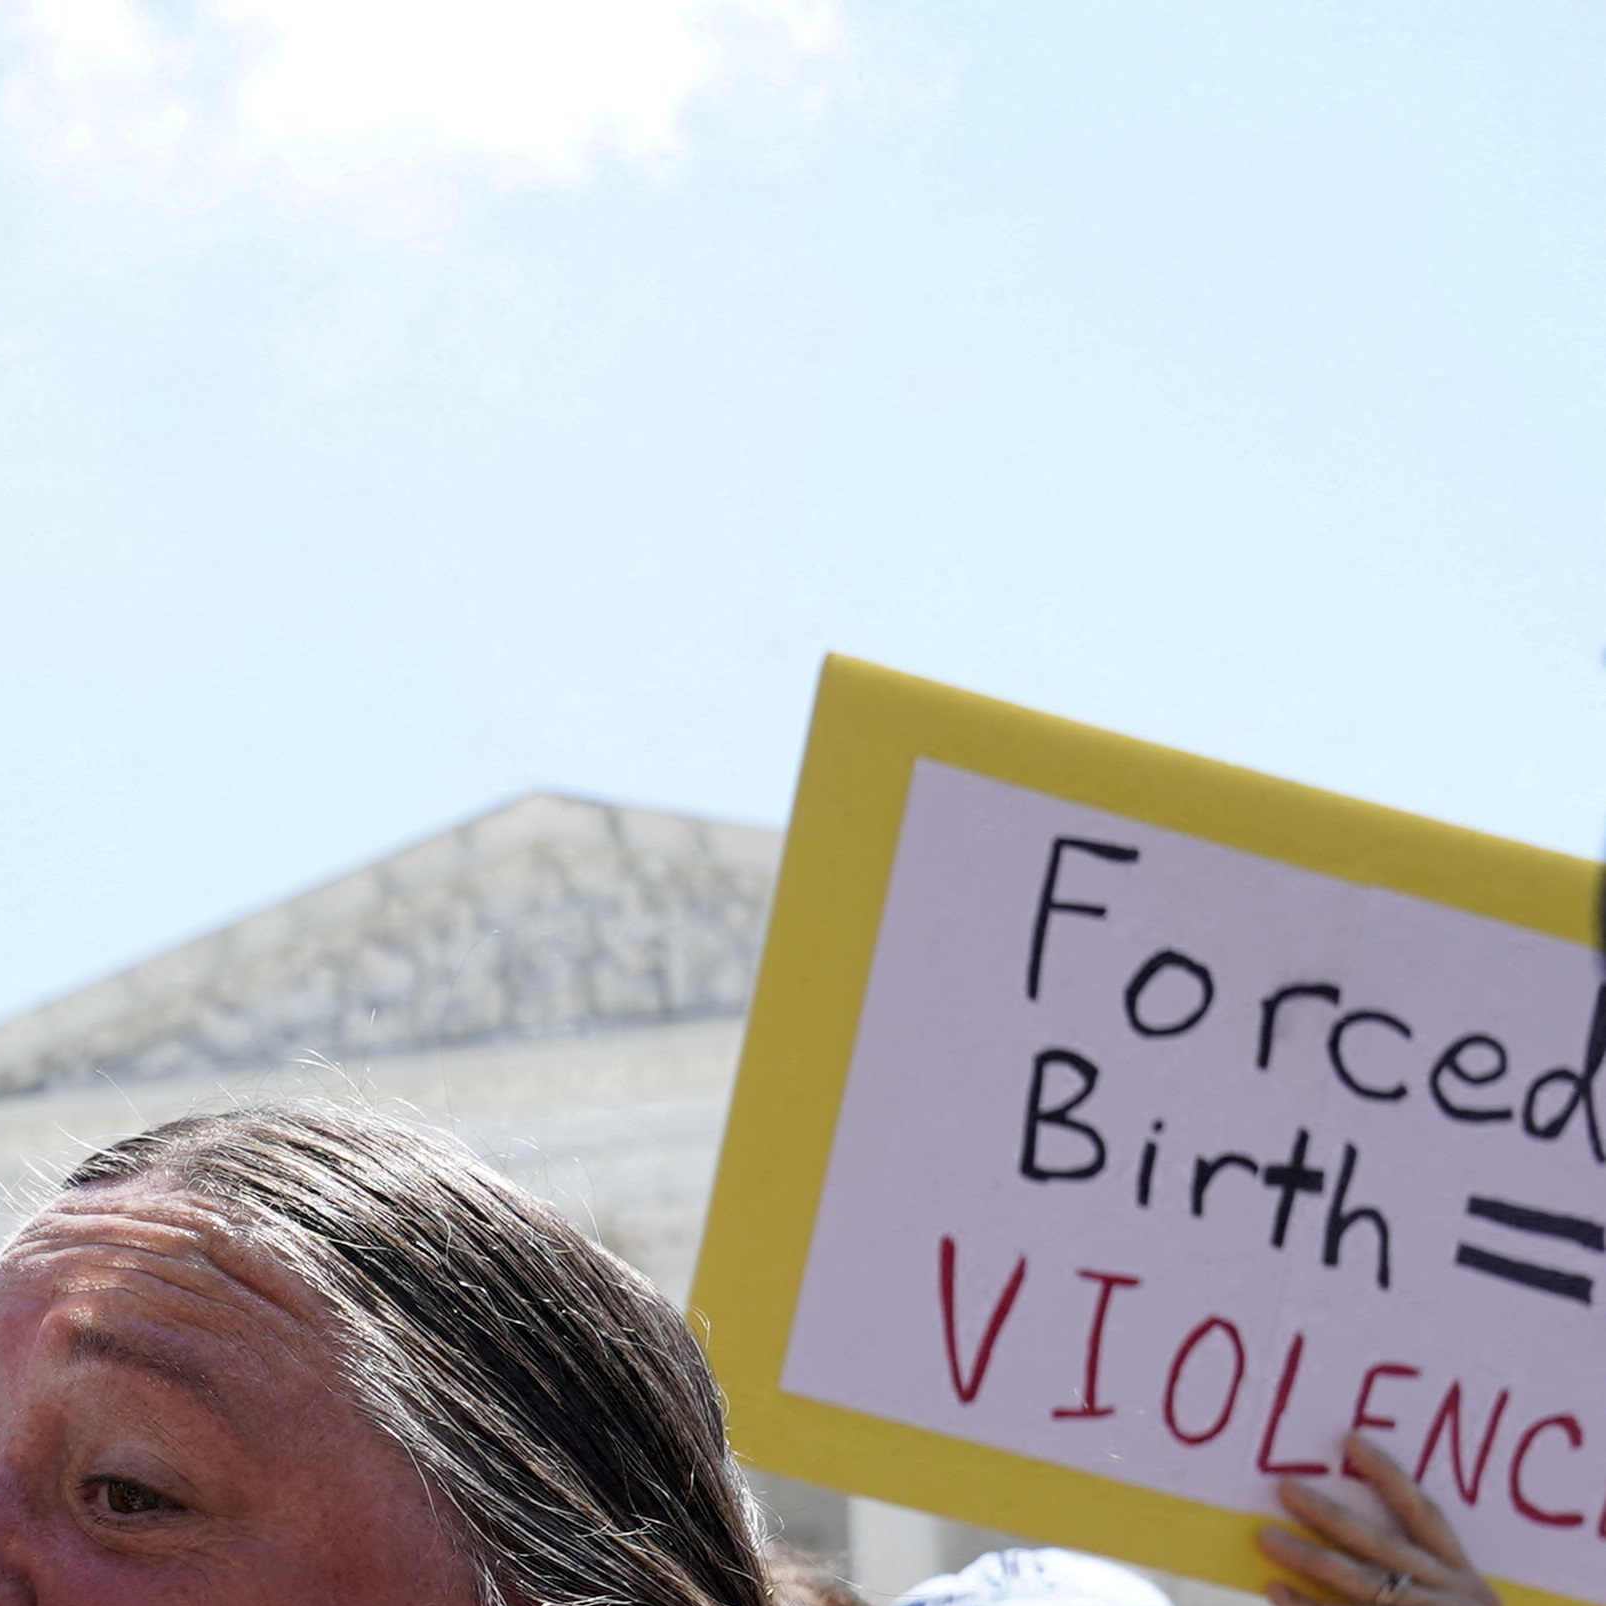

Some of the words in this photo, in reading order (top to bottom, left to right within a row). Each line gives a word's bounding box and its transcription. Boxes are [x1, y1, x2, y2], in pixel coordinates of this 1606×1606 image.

[1027, 835, 1606, 1164] Forced
[1020, 1047, 1391, 1290] Birth
[939, 1235, 1606, 1540] VIOLENC
